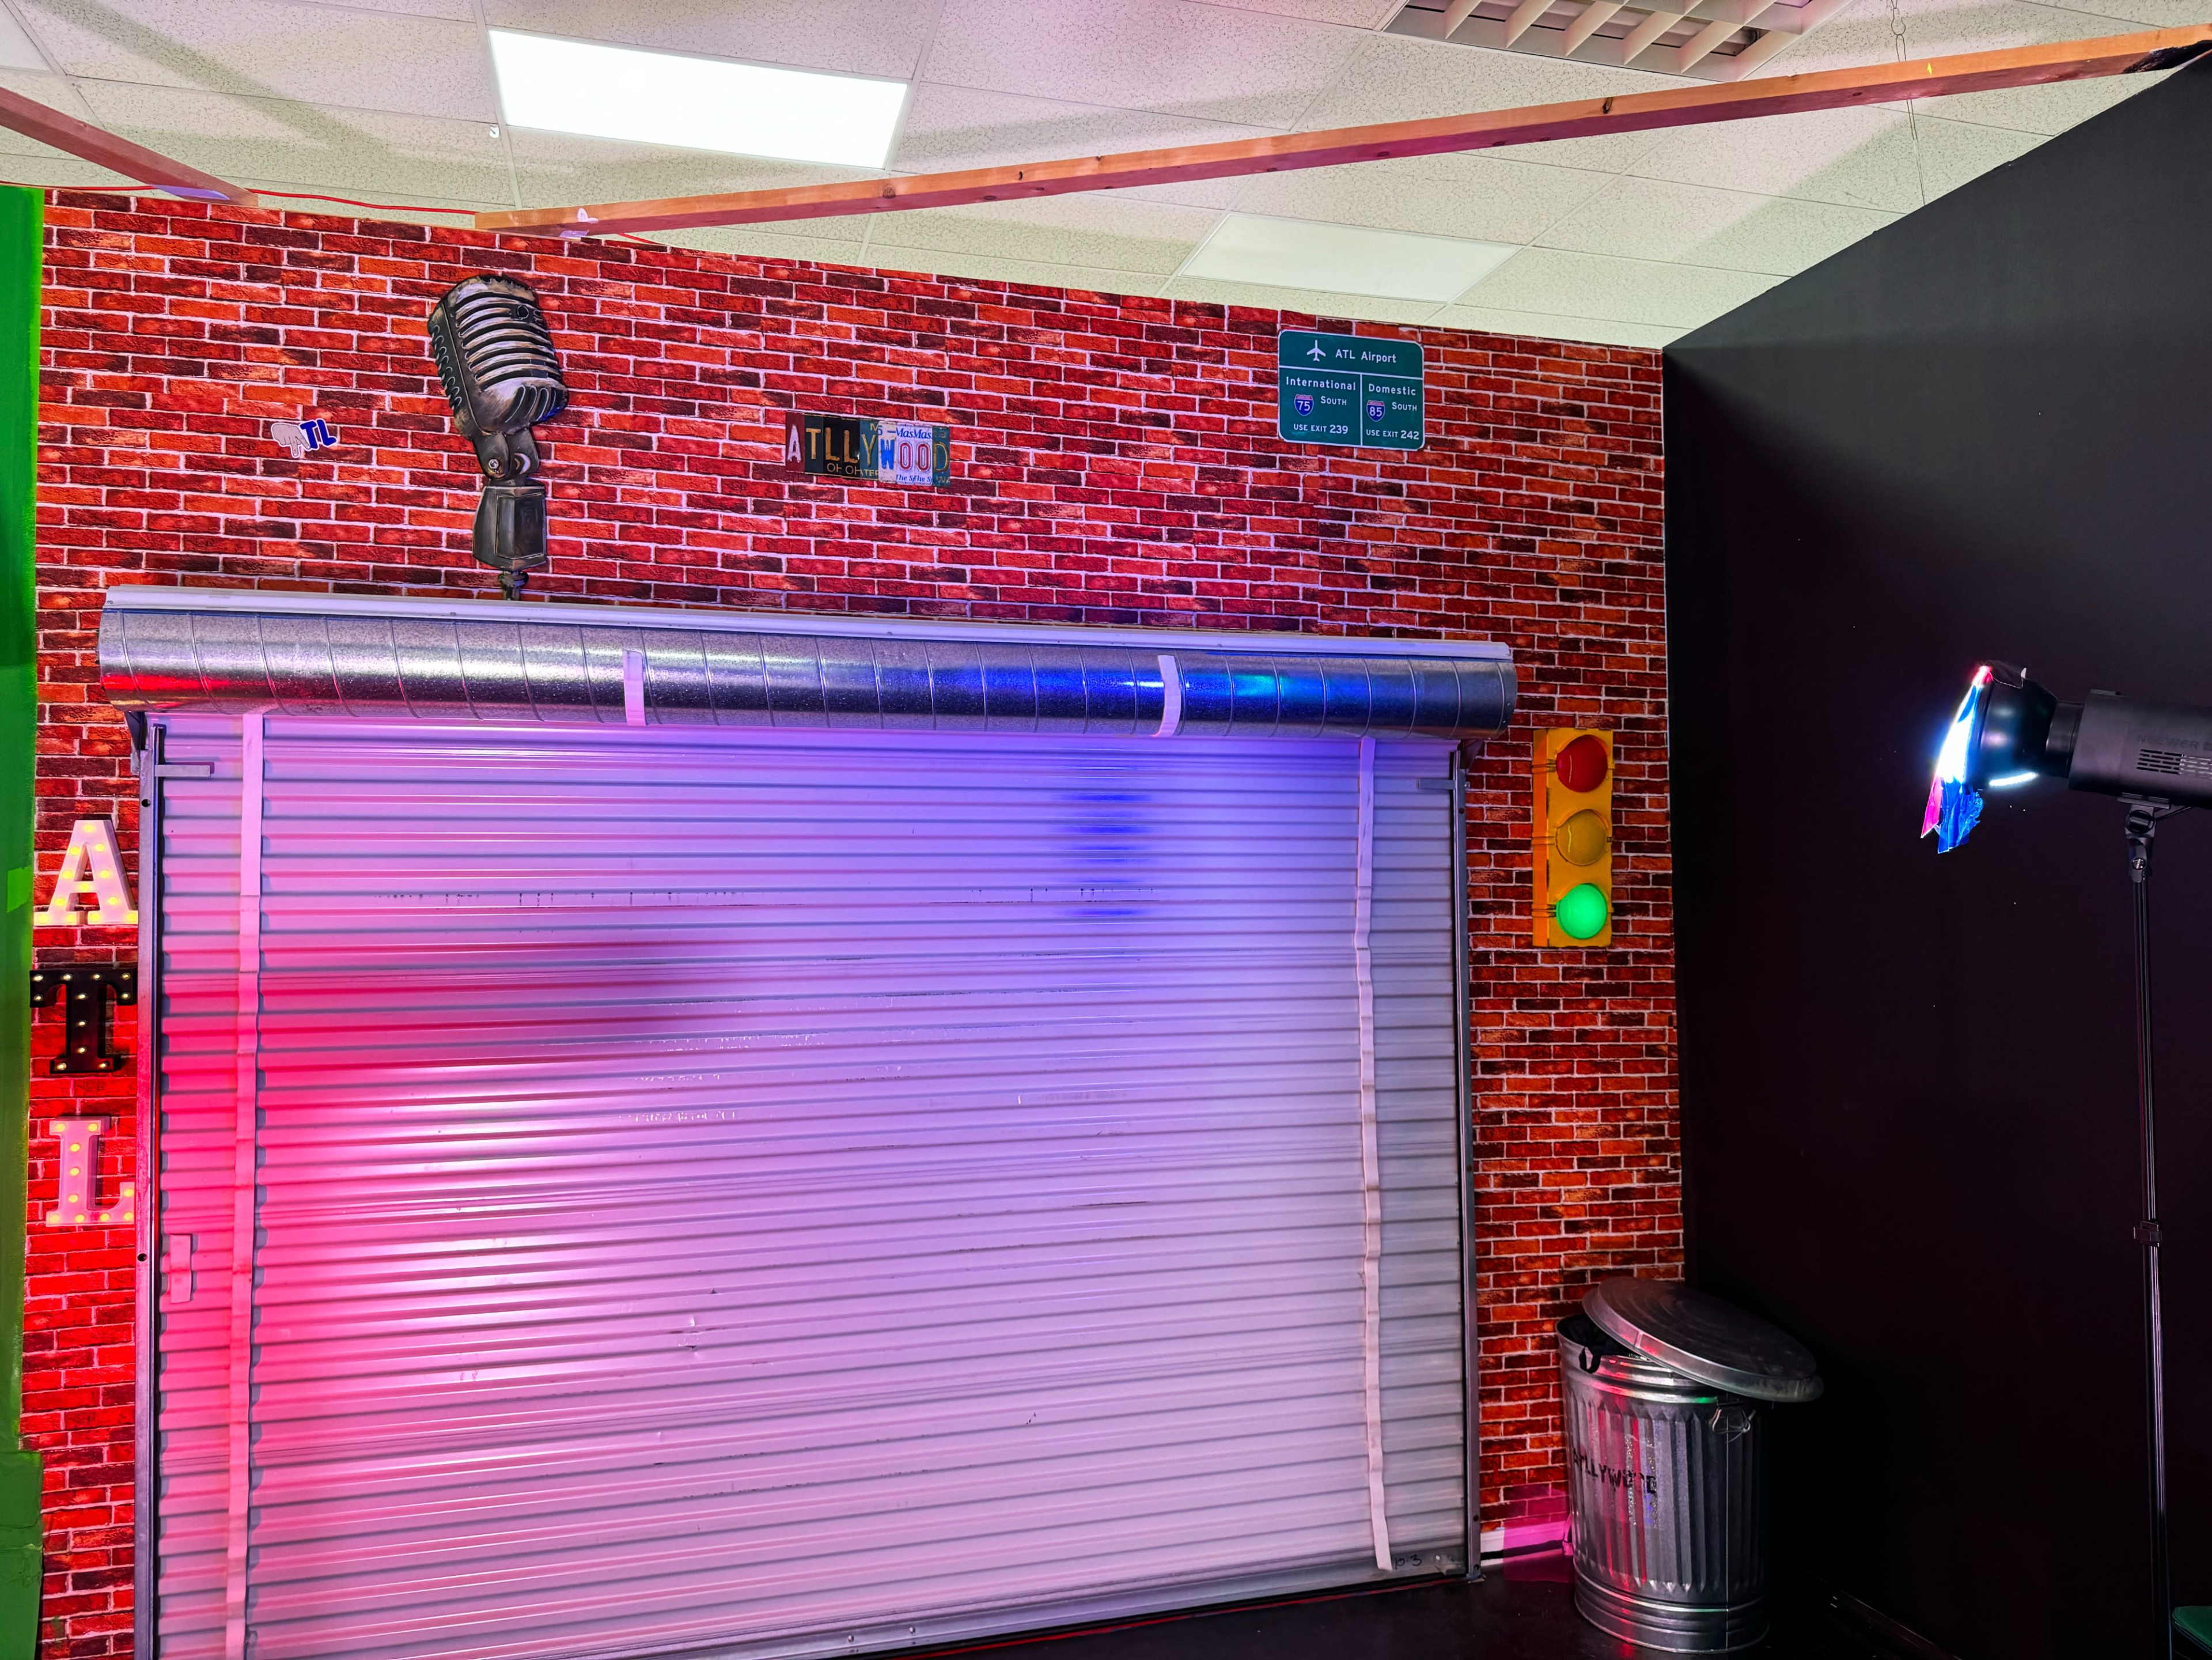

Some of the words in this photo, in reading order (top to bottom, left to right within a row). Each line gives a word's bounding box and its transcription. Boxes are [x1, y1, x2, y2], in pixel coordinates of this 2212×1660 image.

[1335, 348, 1355, 360] ATL
[1361, 351, 1397, 364] Airport
[1286, 376, 1356, 391] International
[1368, 383, 1416, 396] Domestic
[1297, 400, 1310, 411] 75
[1320, 396, 1347, 406] SOUTH
[1369, 406, 1382, 417] 85
[1391, 402, 1418, 411] SOUTH
[1293, 423, 1308, 432] USE
[1310, 425, 1327, 433] EXIT
[1329, 425, 1349, 434] 239
[1382, 430, 1399, 438] EXIT
[1400, 430, 1420, 440] 242
